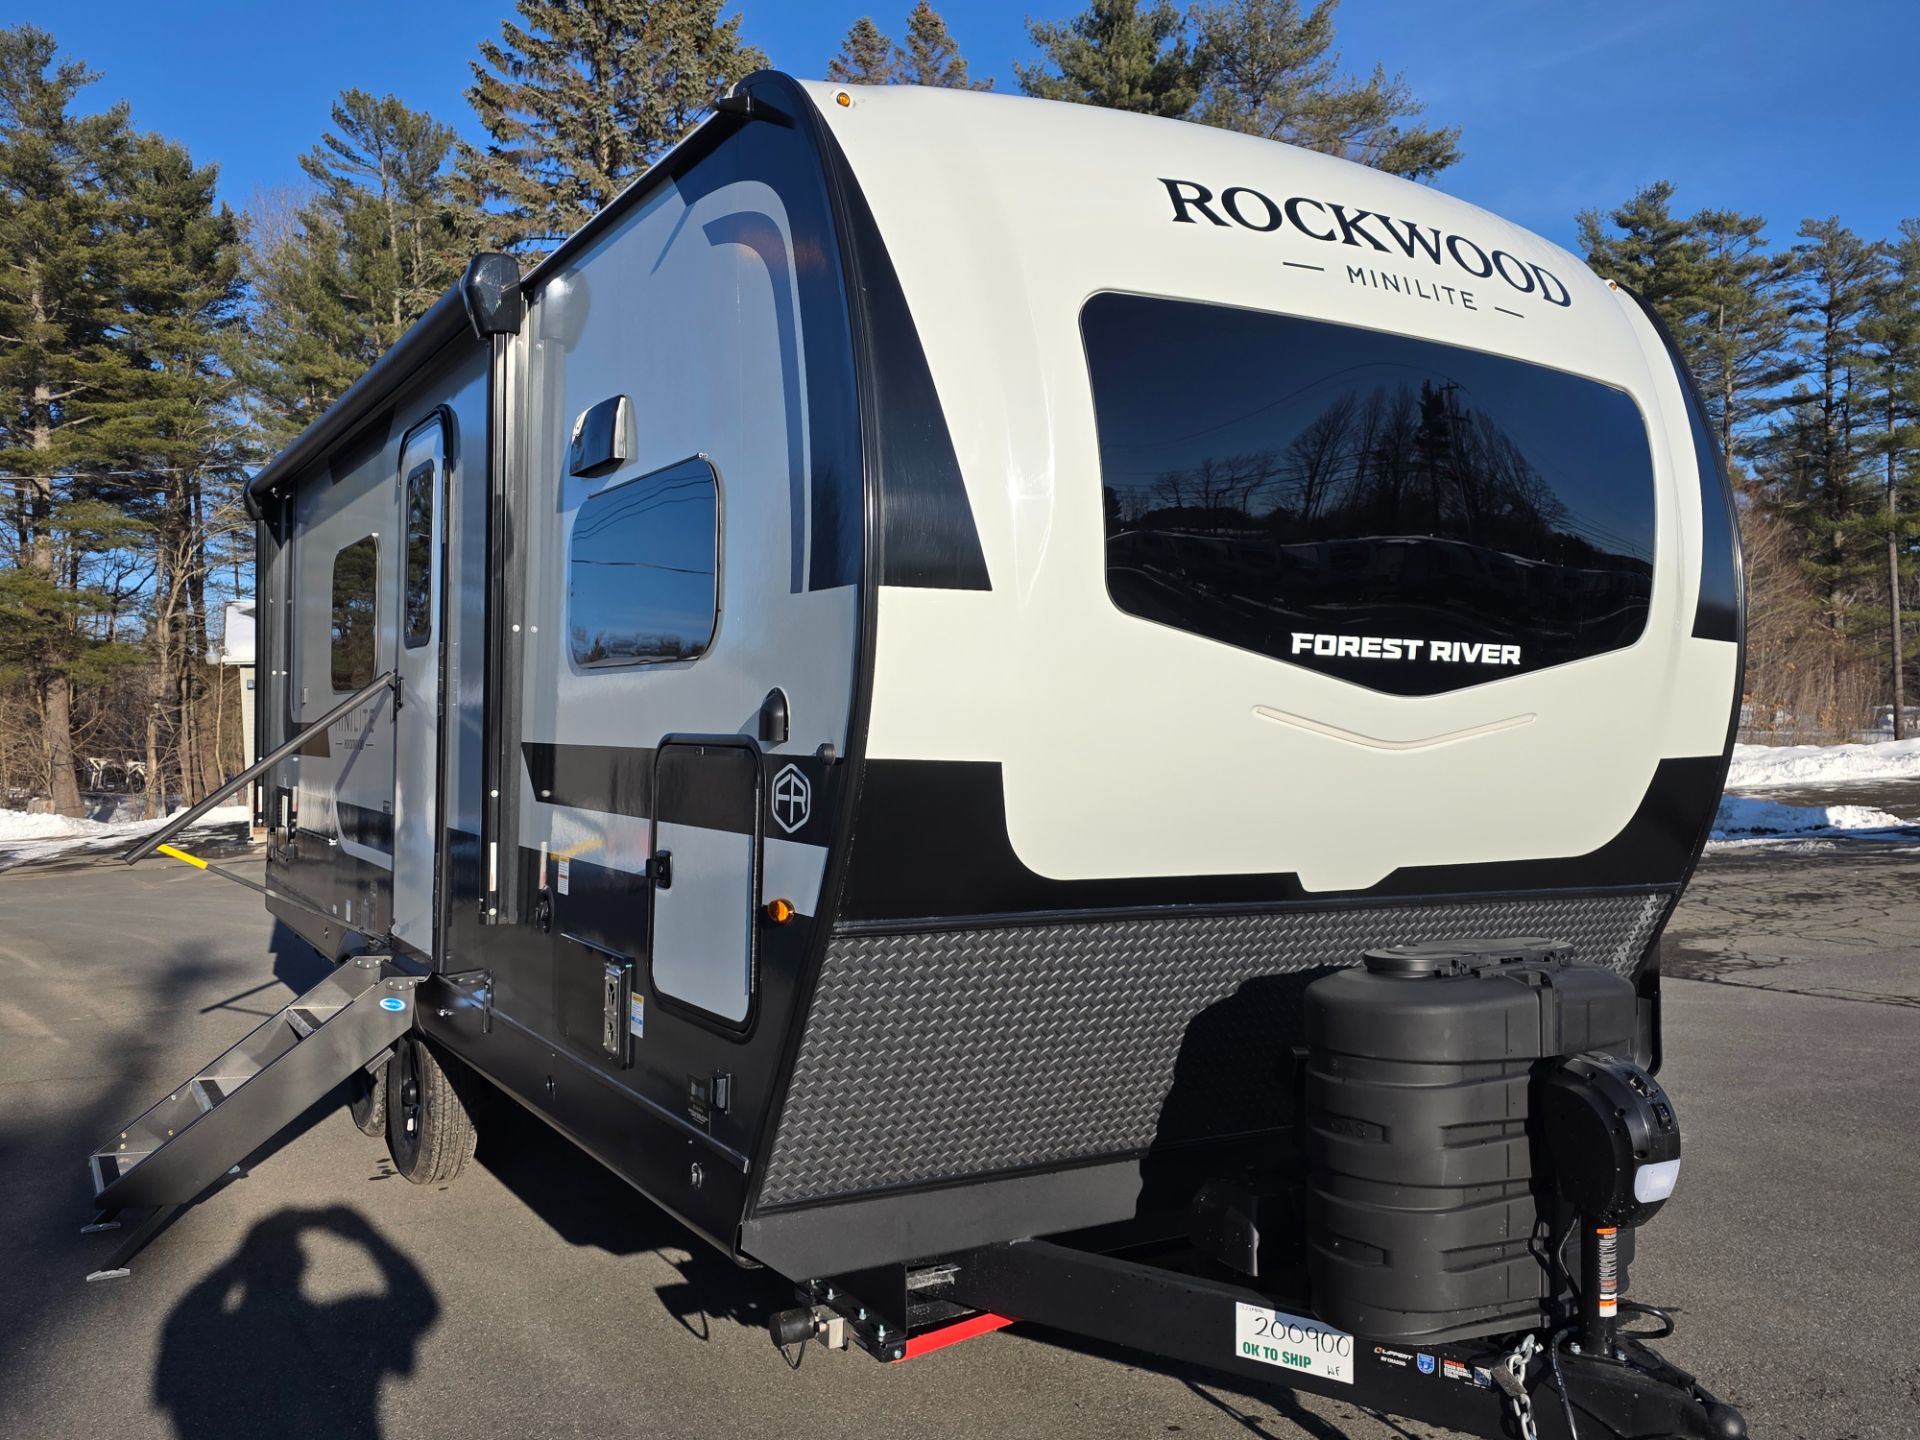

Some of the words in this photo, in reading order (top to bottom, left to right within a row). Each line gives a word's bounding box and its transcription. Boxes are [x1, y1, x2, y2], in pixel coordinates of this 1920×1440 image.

[1157, 177, 1571, 307] ROCKWOOD
[1346, 265, 1478, 311] MINILITE
[1291, 632, 1424, 660] FOREST
[1429, 640, 1521, 665] RIVER
[1243, 1341, 1260, 1356] OK
[1263, 1346, 1278, 1361] TO
[1282, 1351, 1312, 1368] SHIP
[1254, 1317, 1350, 1357] 200900
